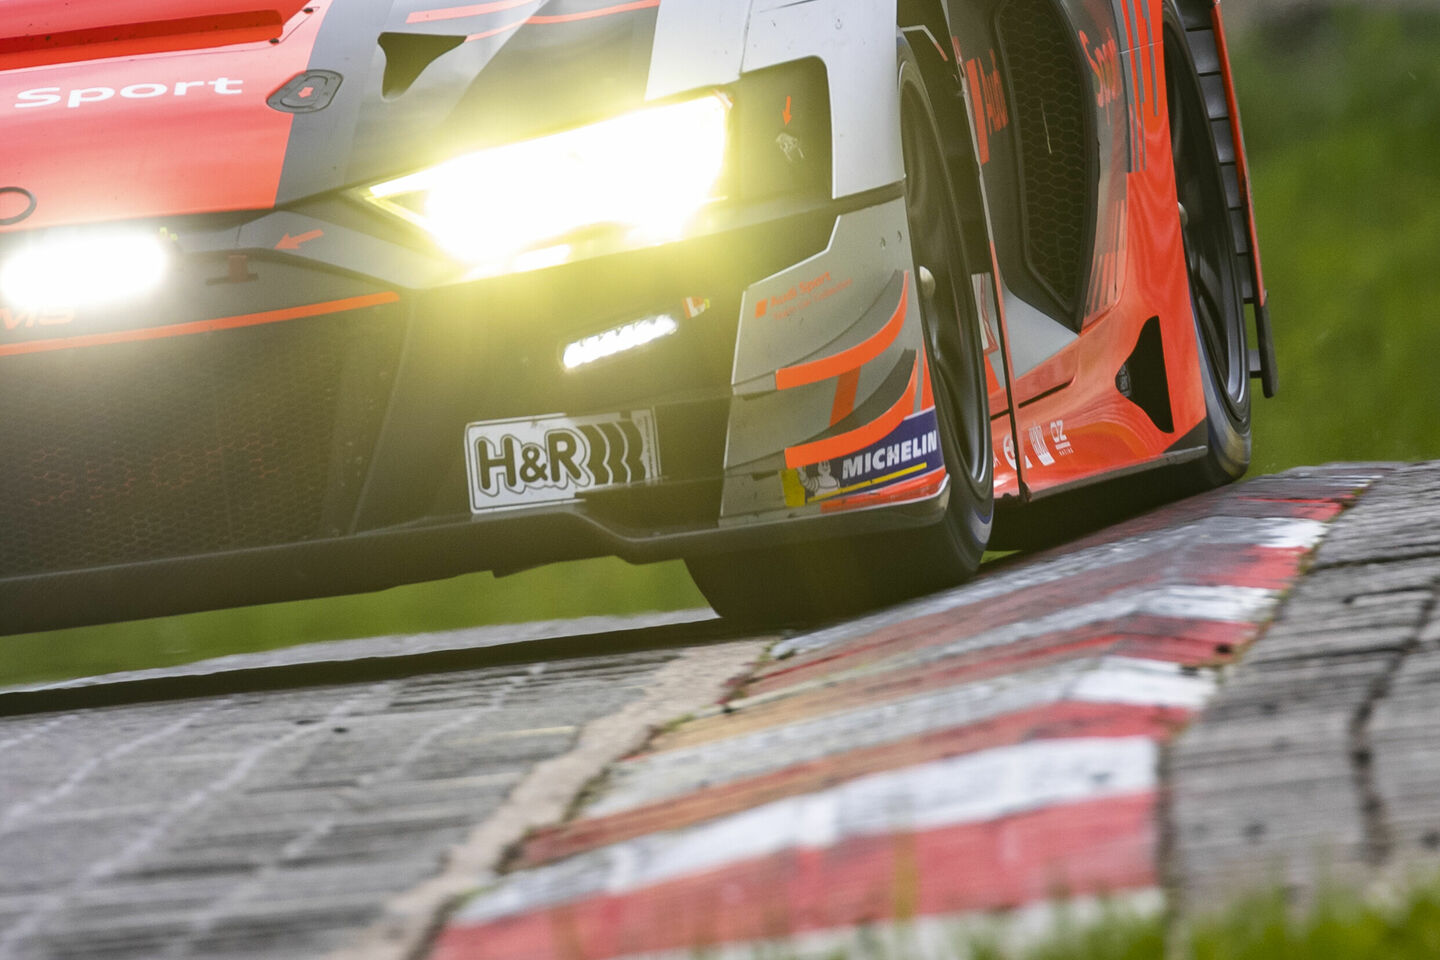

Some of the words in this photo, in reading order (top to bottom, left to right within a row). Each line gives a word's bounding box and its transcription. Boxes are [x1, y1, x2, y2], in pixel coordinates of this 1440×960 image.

[14, 76, 244, 109] Sport
[476, 432, 582, 490] H&R
[842, 430, 938, 480] MICHELIN
